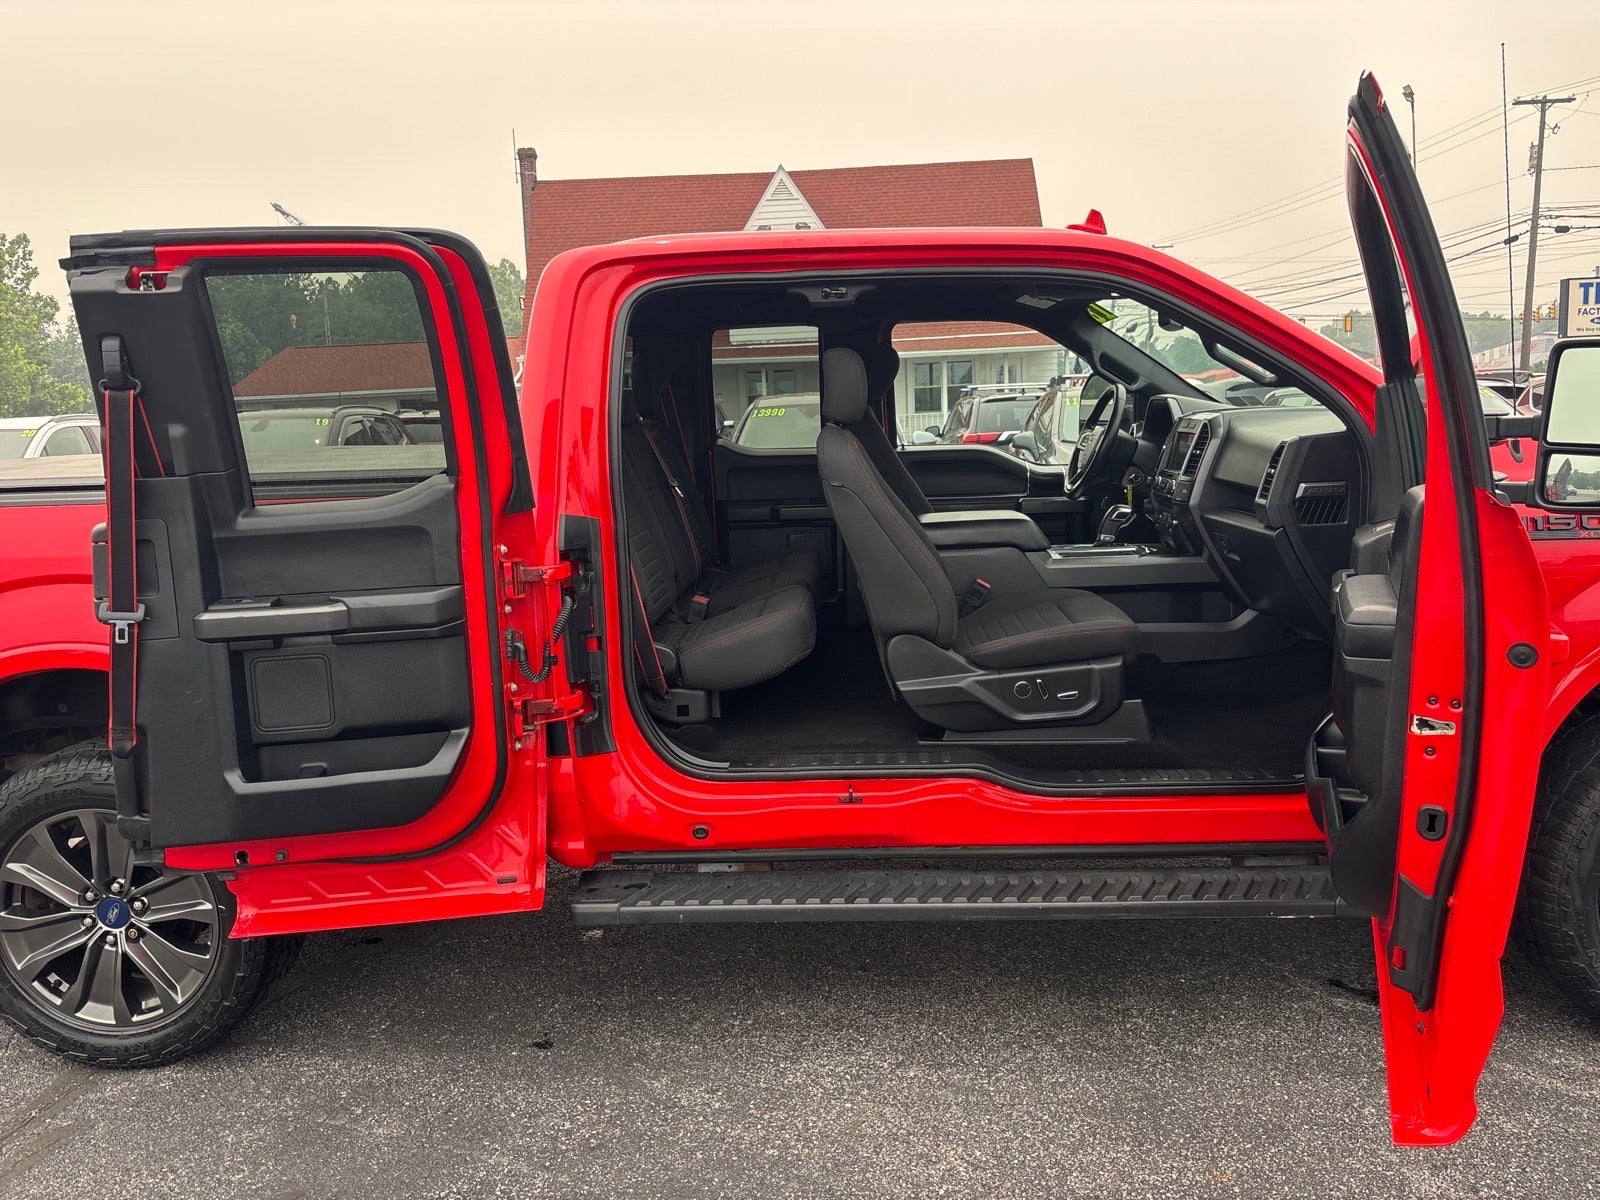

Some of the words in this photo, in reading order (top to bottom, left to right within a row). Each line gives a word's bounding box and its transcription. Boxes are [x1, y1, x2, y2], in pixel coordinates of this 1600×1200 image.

[751, 408, 786, 418] 13990
[315, 418, 329, 426] 19
[19, 430, 37, 438] 20
